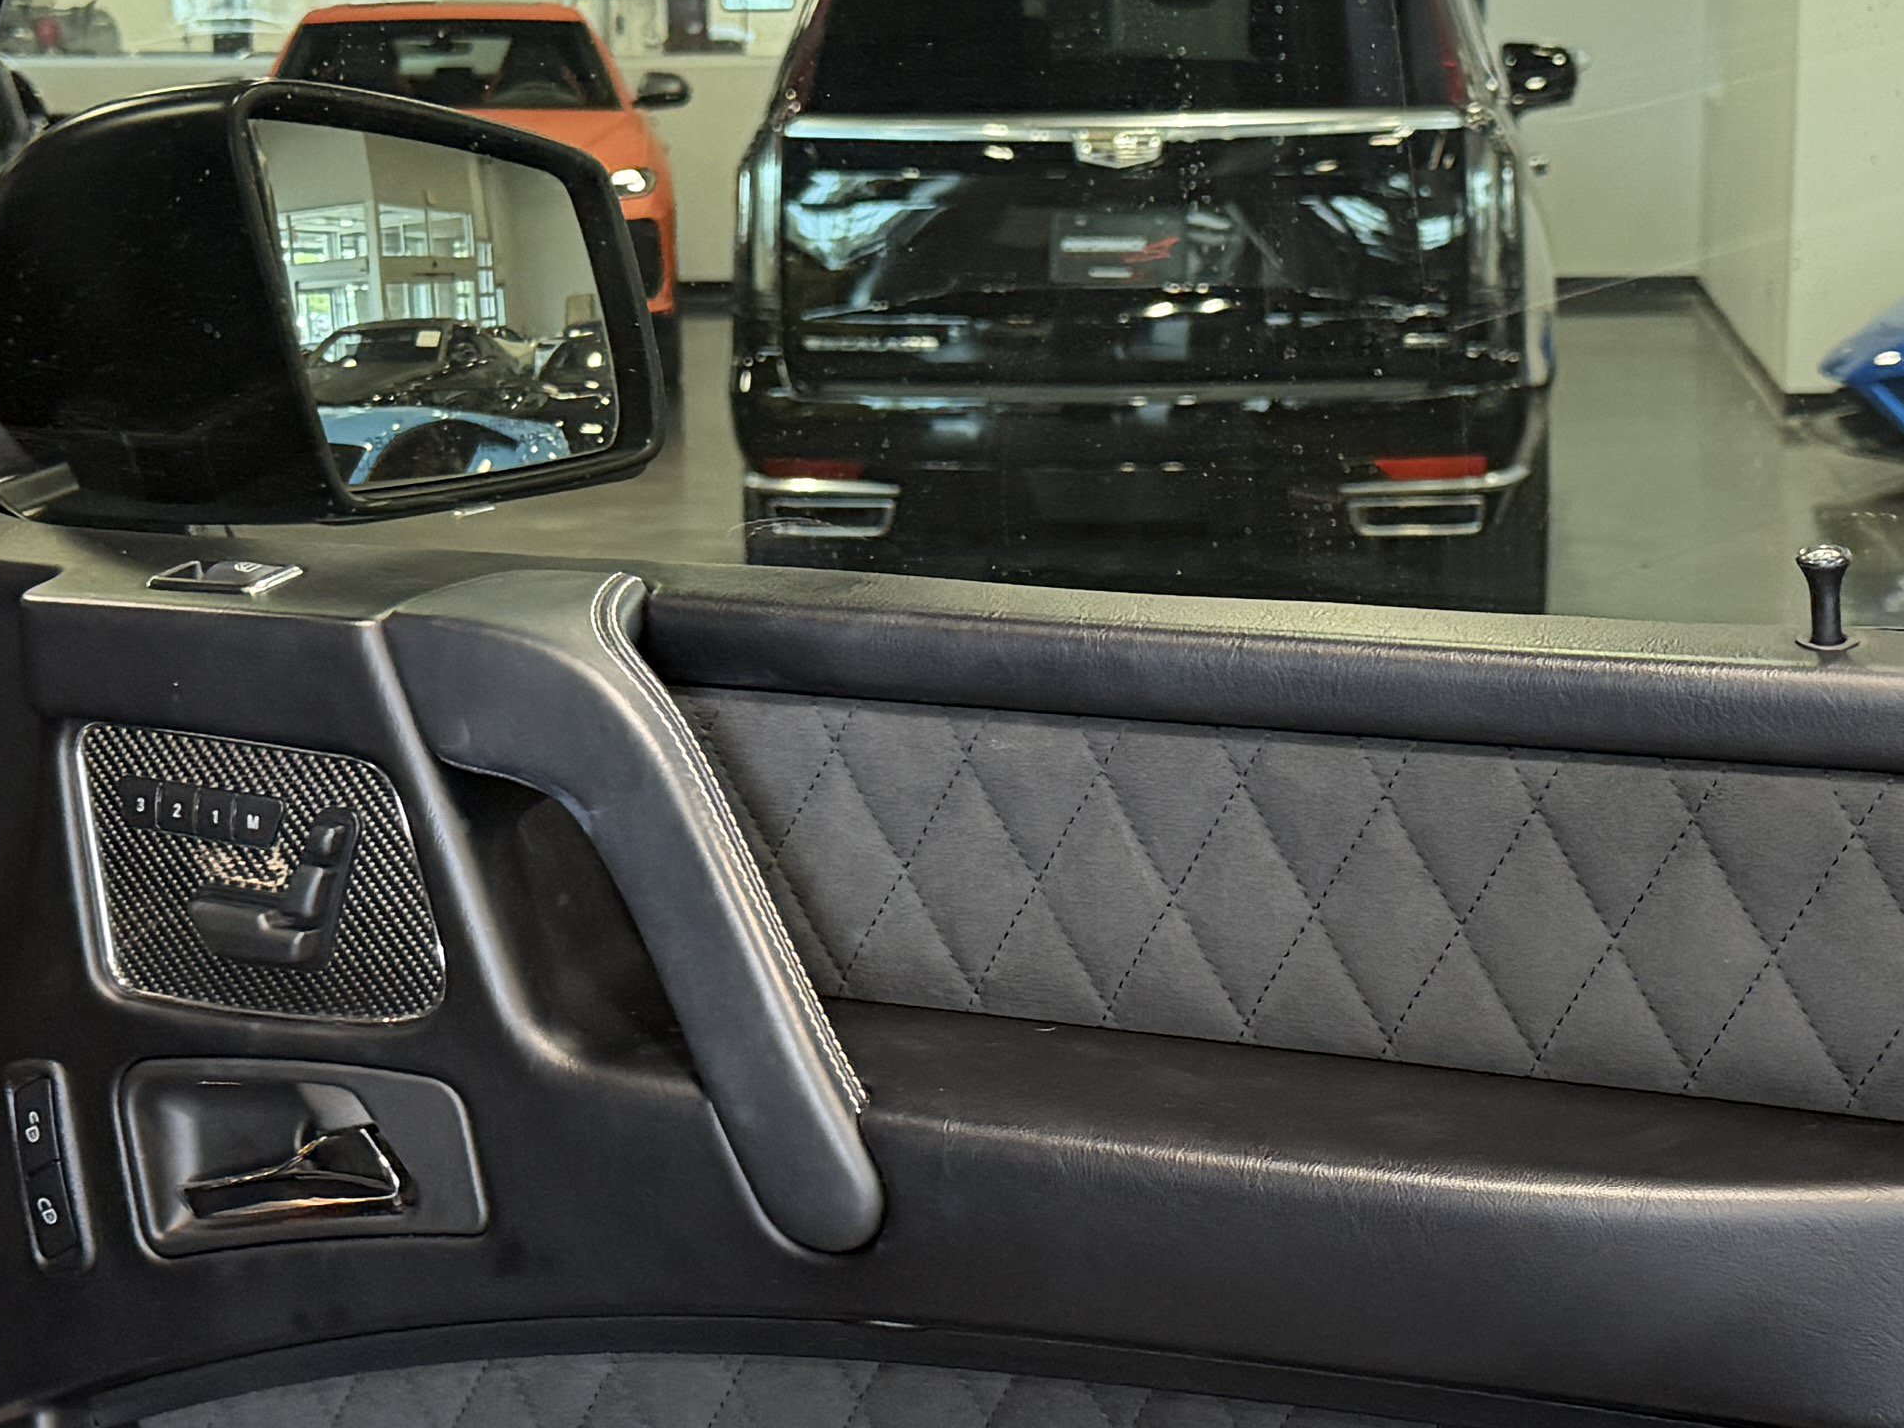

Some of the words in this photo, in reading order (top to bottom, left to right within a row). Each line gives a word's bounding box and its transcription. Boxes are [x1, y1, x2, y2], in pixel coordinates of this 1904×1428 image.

[136, 797, 145, 813] 3
[172, 802, 182, 818] 2
[211, 809, 219, 824] 1
[246, 814, 260, 830] M
